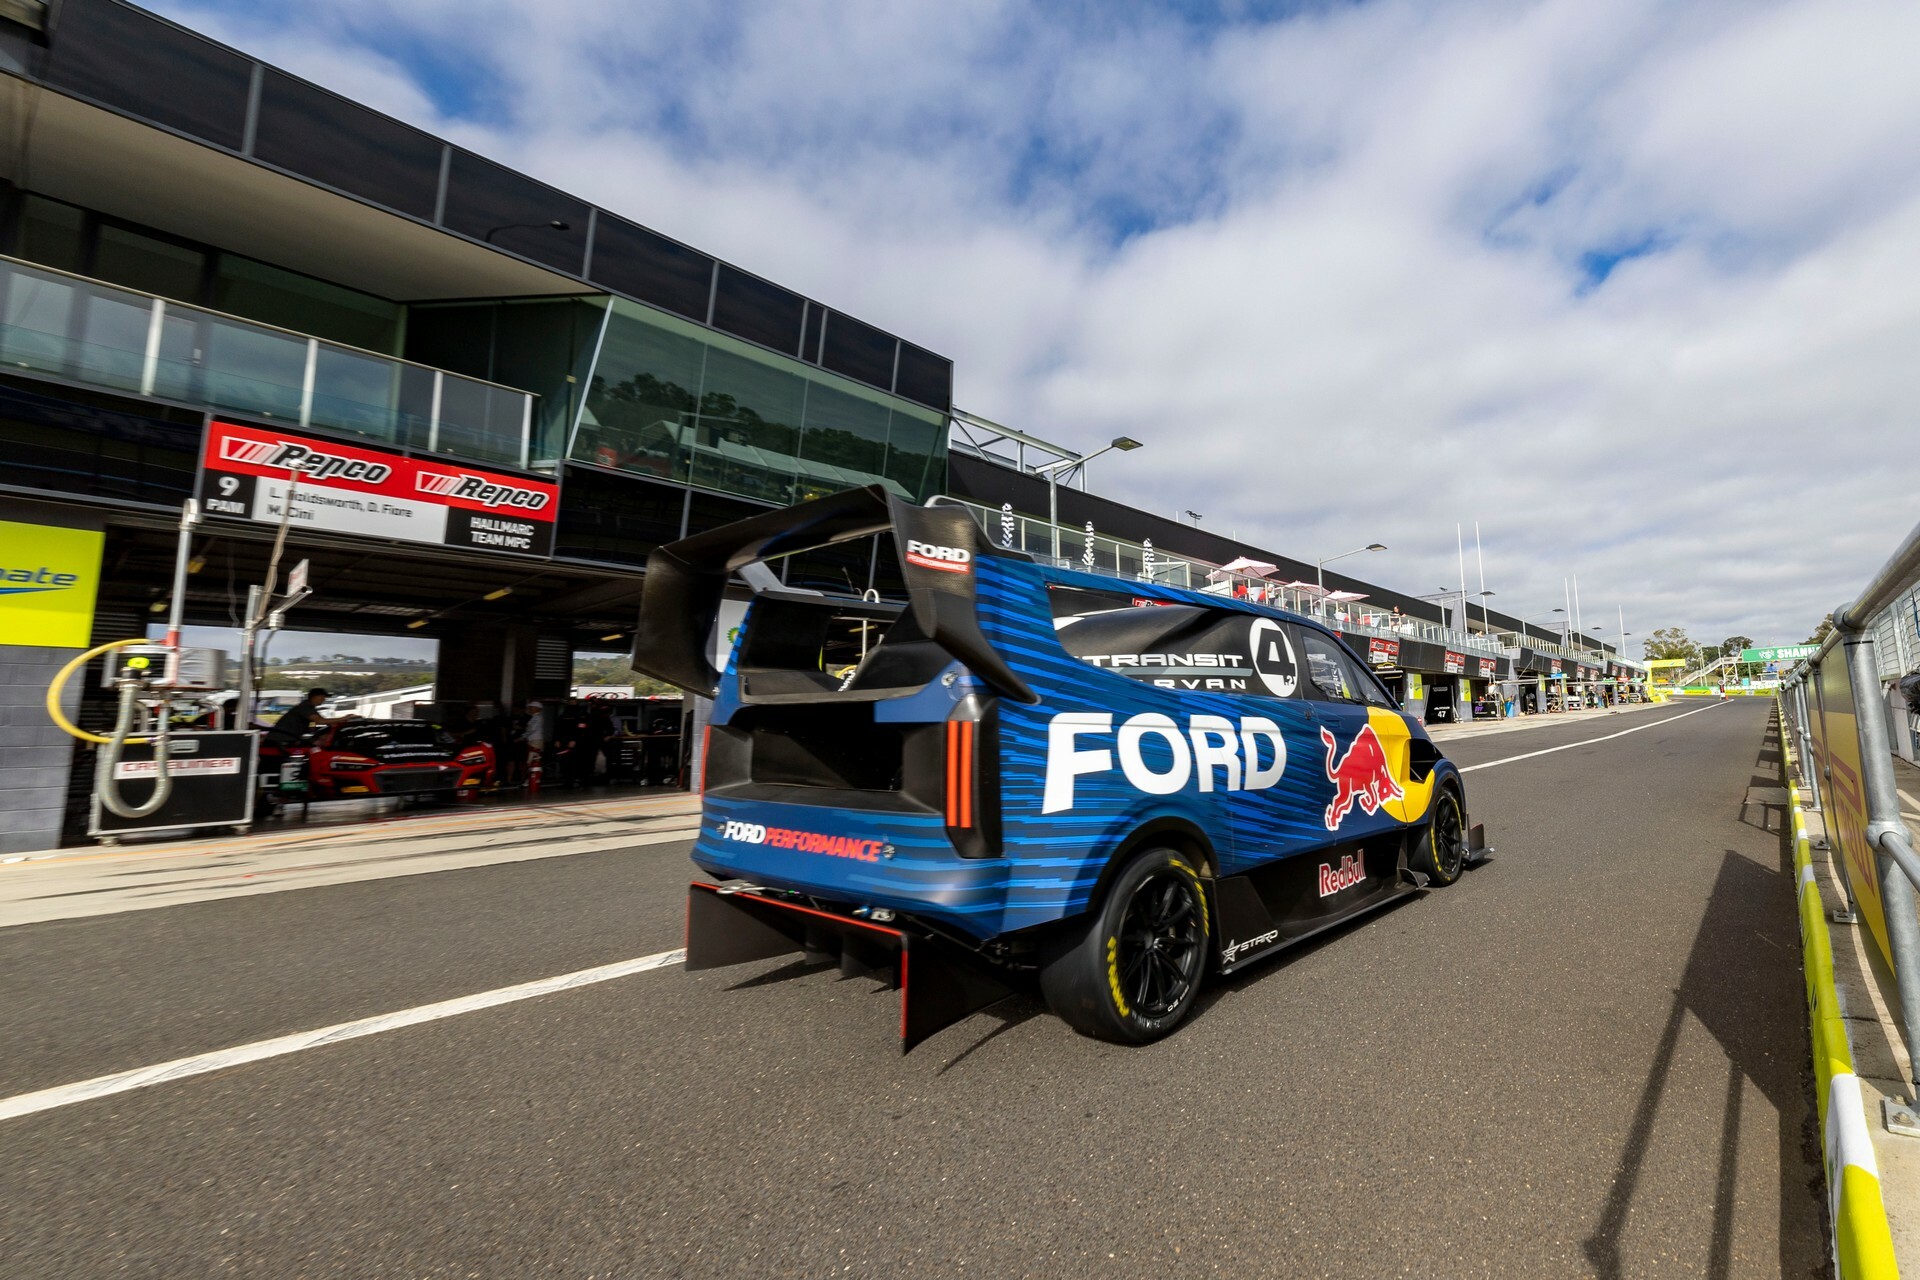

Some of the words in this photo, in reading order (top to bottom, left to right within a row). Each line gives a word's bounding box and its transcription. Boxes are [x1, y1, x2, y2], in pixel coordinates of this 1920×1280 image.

[271, 440, 392, 484] Repco
[218, 476, 240, 497] 9
[454, 474, 550, 510] Repco
[470, 516, 535, 536] HALLMARC
[471, 531, 504, 546] TEAM
[907, 539, 971, 563] FORD
[1041, 712, 1287, 815] FORD
